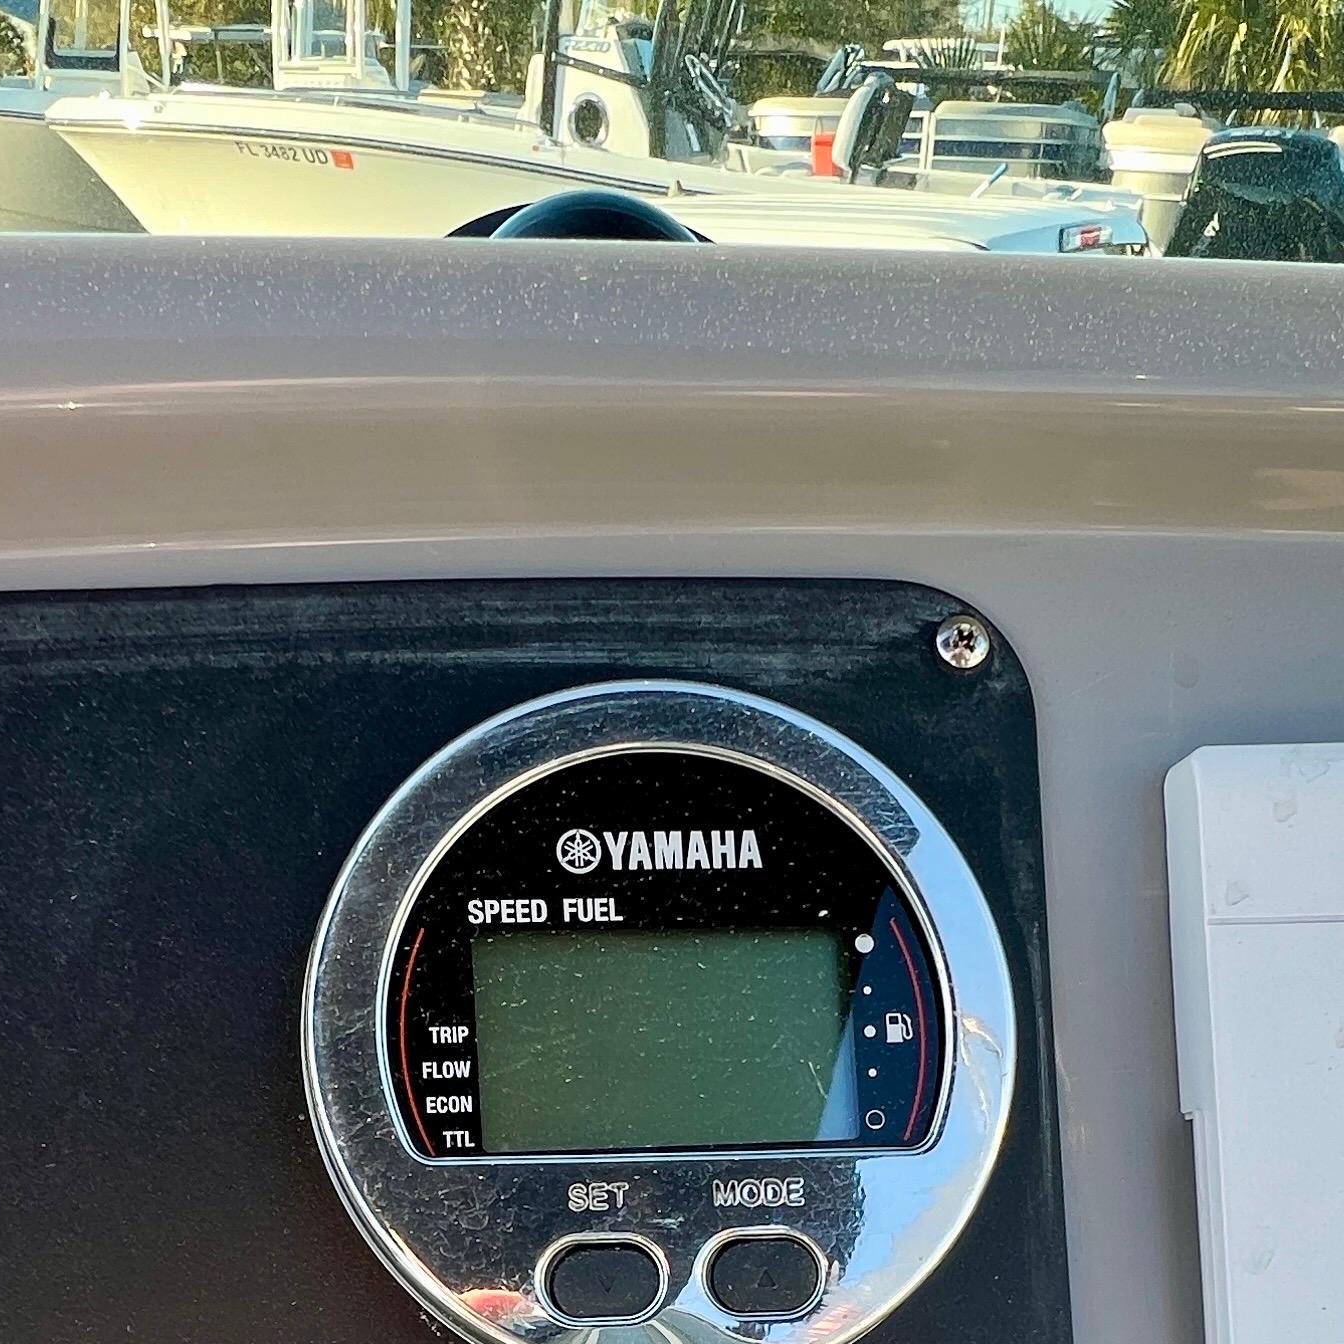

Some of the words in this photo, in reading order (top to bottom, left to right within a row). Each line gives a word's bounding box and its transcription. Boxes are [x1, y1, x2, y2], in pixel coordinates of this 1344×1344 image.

[234, 140, 259, 157] FL
[260, 144, 301, 162] 3482
[303, 147, 329, 165] UD
[603, 829, 763, 871] YAMAHA
[467, 899, 548, 925] SPEED
[562, 897, 624, 923] FUEL
[428, 1025, 469, 1044] TRIP
[422, 1060, 471, 1079] FLOW
[425, 1095, 473, 1114] ECON
[442, 1130, 476, 1149] TTL
[568, 1182, 629, 1212] SET
[712, 1177, 805, 1207] MODE
